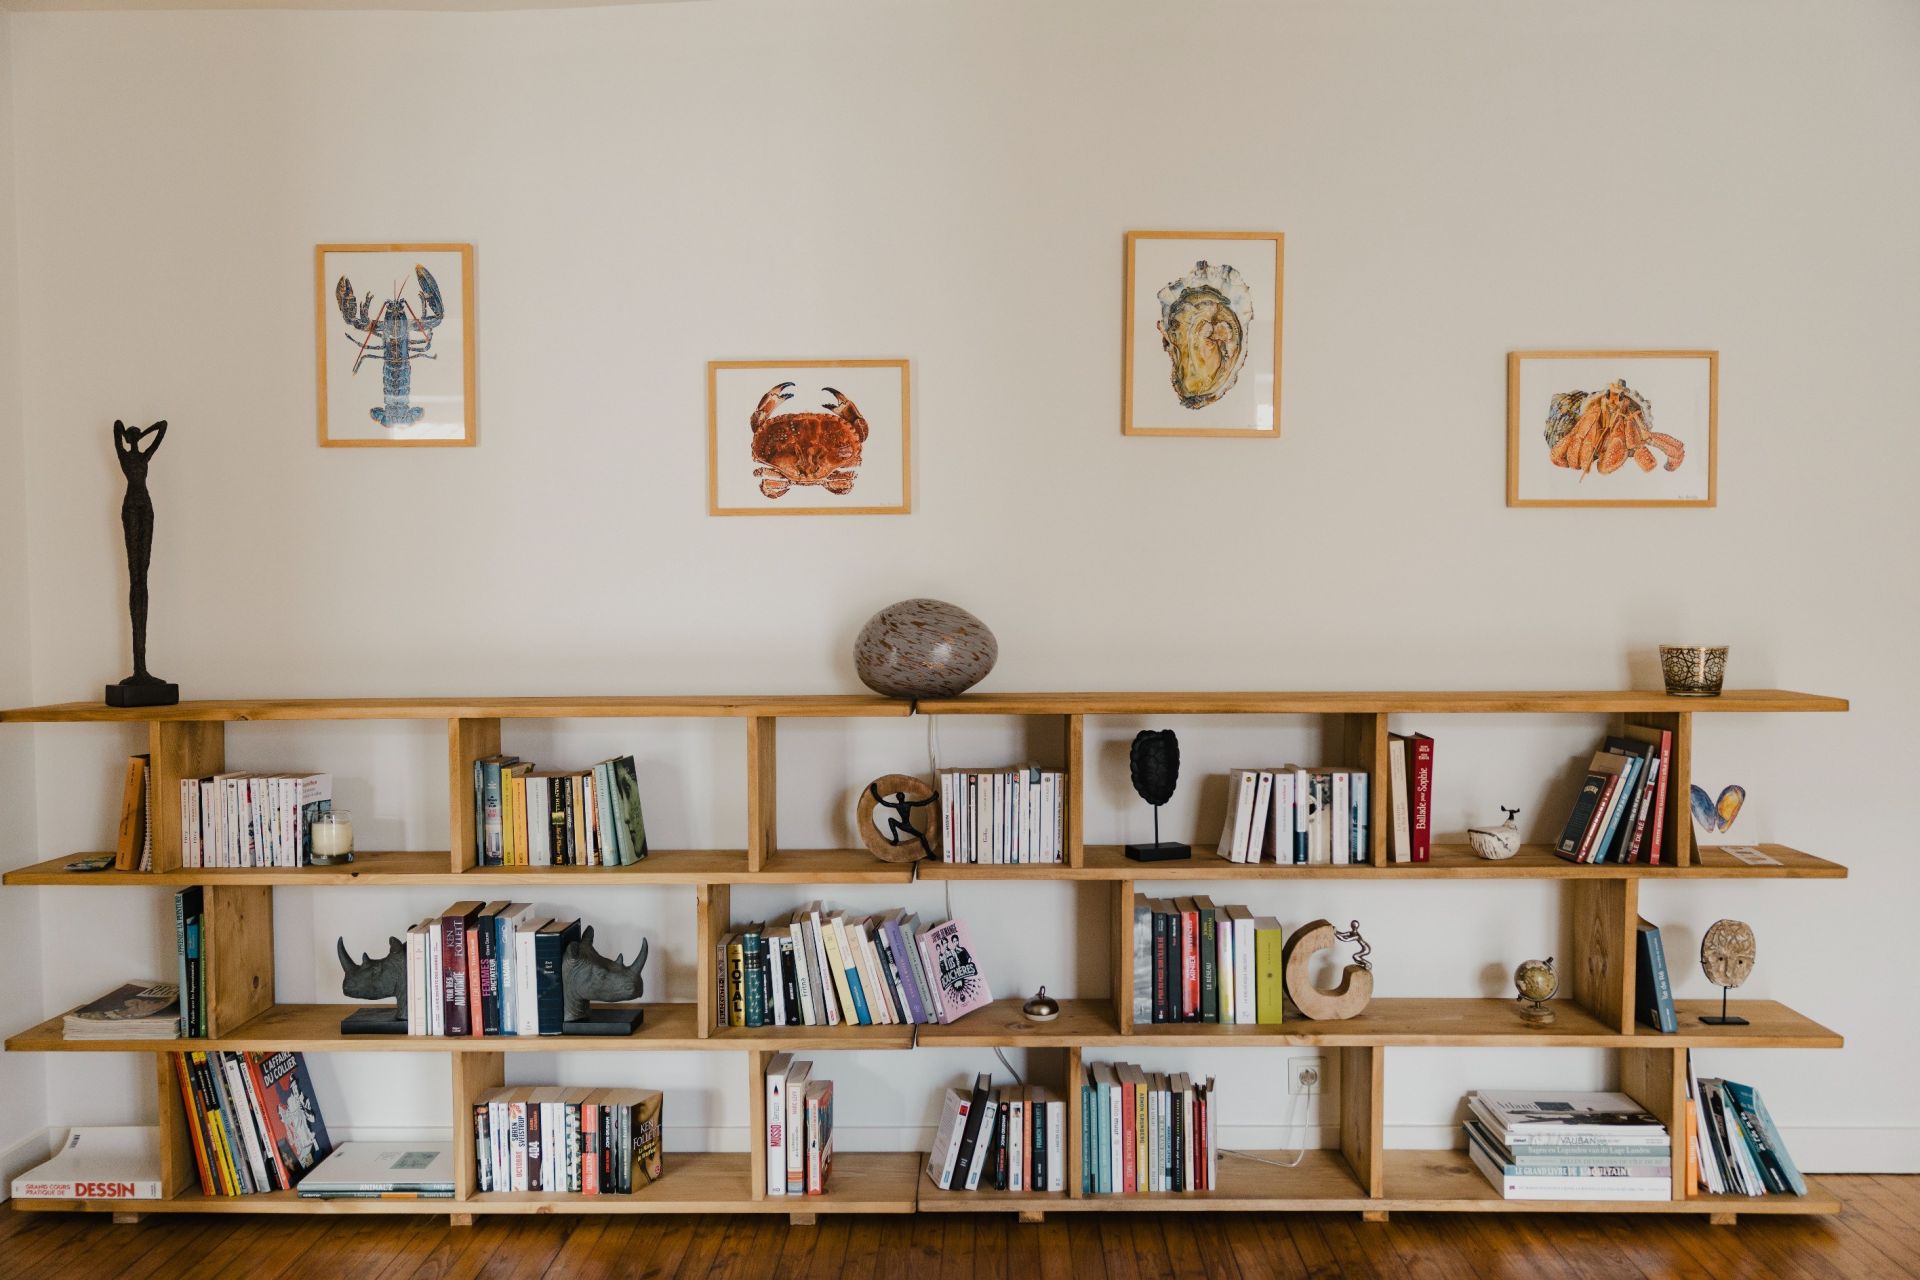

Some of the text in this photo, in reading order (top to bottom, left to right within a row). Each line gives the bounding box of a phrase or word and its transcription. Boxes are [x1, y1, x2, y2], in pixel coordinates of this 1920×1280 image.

[1417, 767, 1429, 792] Sophie
[1416, 802, 1427, 830] Ballade
[1637, 821, 1645, 831] RÉ
[1635, 832, 1642, 842] DE
[175, 895, 183, 921] PEINTURE
[446, 930, 456, 948] KEN
[453, 919, 464, 958] FOLLETT
[480, 958, 491, 997] FEMMES
[489, 958, 497, 991] DICTATEUR
[1204, 962, 1212, 991] LE RÉSEAU
[1657, 970, 1665, 980] Ré
[1659, 980, 1667, 990] de
[453, 971, 466, 1006] AU MONDE
[731, 959, 743, 1013] TOTAL
[800, 977, 809, 998] Fritna
[264, 1057, 297, 1087] DU COLLIER
[511, 1121, 519, 1142] SØREN
[517, 1115, 526, 1148] SVEISTRUP
[633, 1124, 662, 1150] FOLLETT
[770, 1124, 782, 1148] MUSSO
[1560, 1136, 1597, 1145] VAUBAN
[528, 1140, 540, 1159] 404
[1515, 1167, 1523, 1176] LE
[1547, 1167, 1568, 1176] LIVRE
[25, 1183, 71, 1191] GRAND COURS
[25, 1189, 56, 1197] PRATIQUE
[74, 1182, 135, 1198] DESSIN
